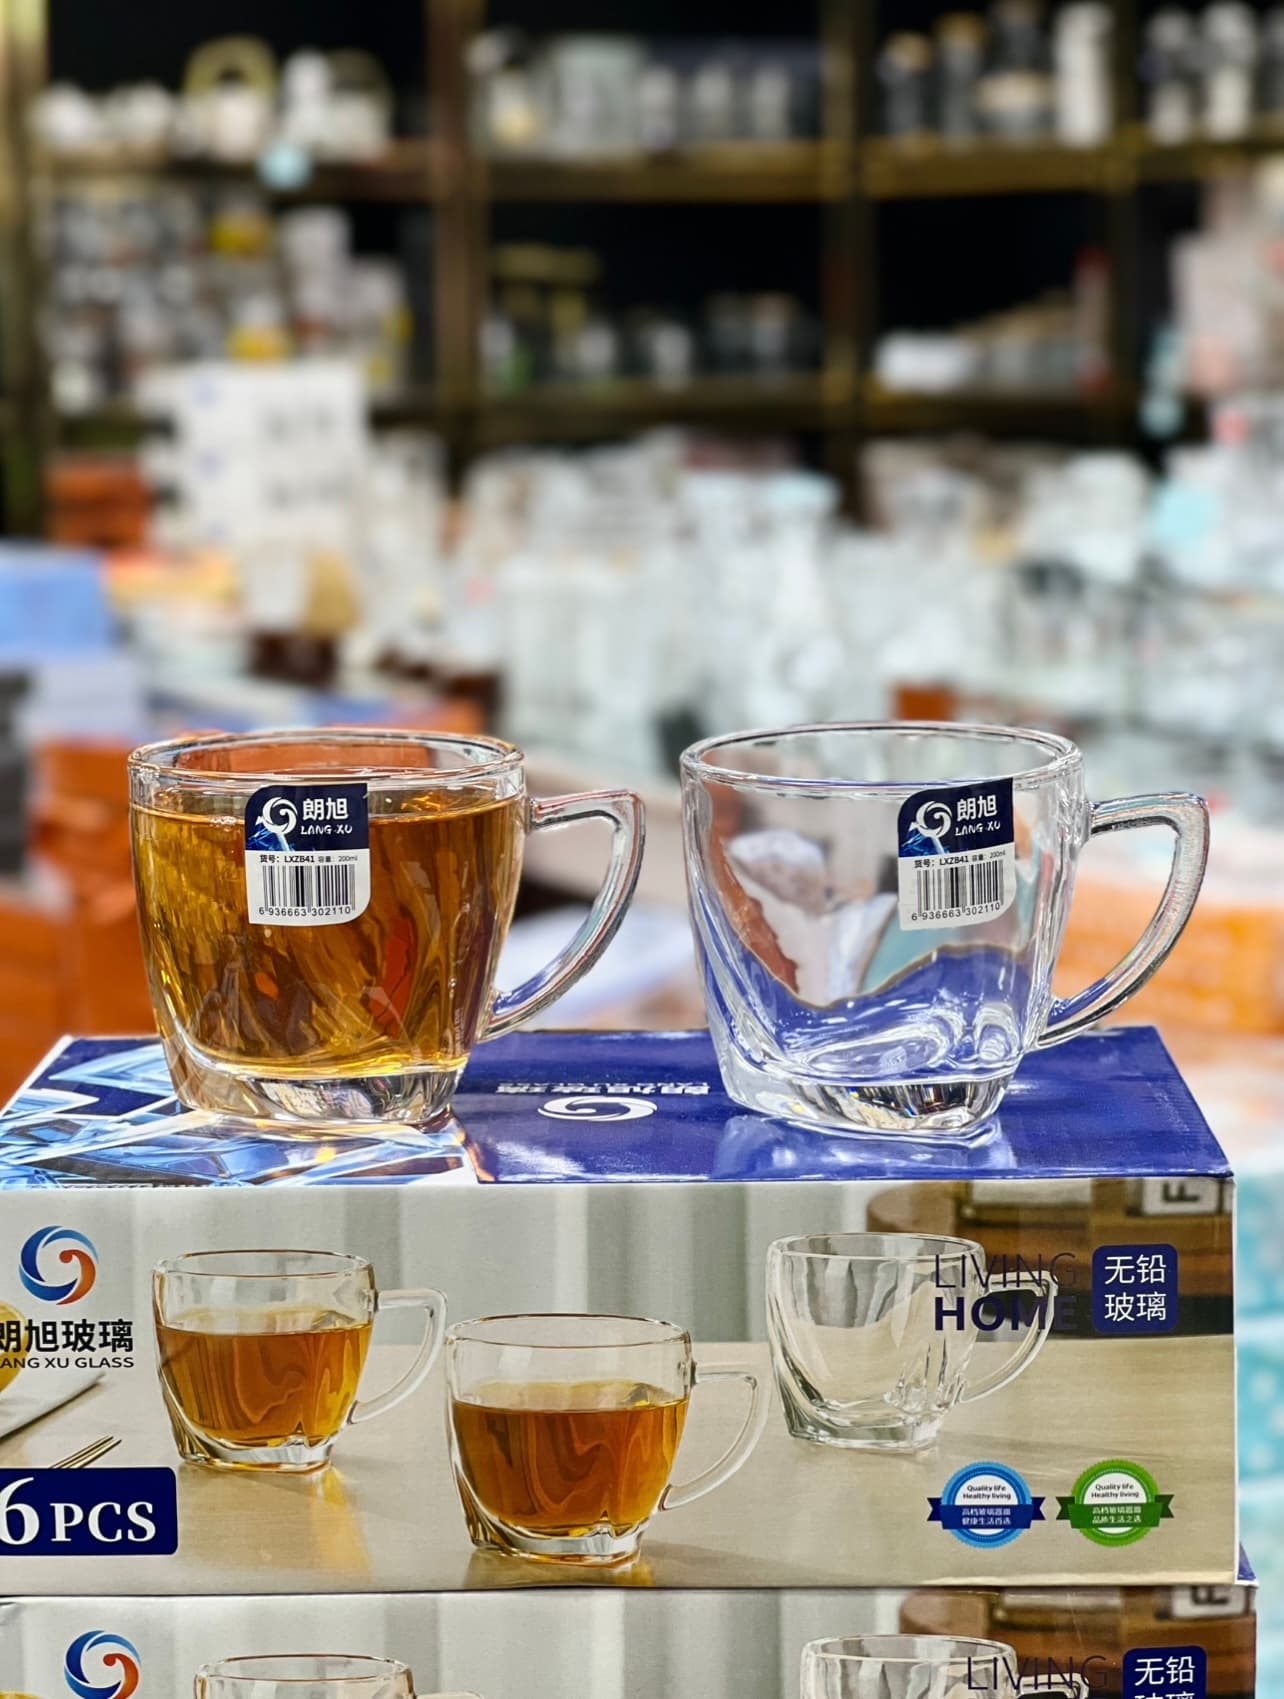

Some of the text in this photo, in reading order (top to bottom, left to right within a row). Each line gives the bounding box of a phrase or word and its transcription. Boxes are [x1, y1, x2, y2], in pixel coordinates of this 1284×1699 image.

[303, 799, 348, 821] 朗旭
[956, 795, 997, 821] 朗旭
[284, 855, 315, 863] LXZB41
[939, 855, 969, 866] LXZB41
[935, 1252, 1077, 1288] LIVING
[1104, 1253, 1167, 1285] 无铅
[935, 1296, 1078, 1330] HOME
[1104, 1291, 1167, 1322] 玻璃
[0, 1318, 134, 1353] 朗旭玻璃
[45, 1357, 69, 1369] XU
[75, 1357, 134, 1369] GLASS
[966, 1484, 992, 1492] Quality
[1095, 1483, 1121, 1491] Quality
[1120, 1491, 1139, 1499] living
[0, 1476, 156, 1546] 6 PCS
[967, 1655, 1107, 1691] LIVING
[1134, 1656, 1196, 1687] 无铅
